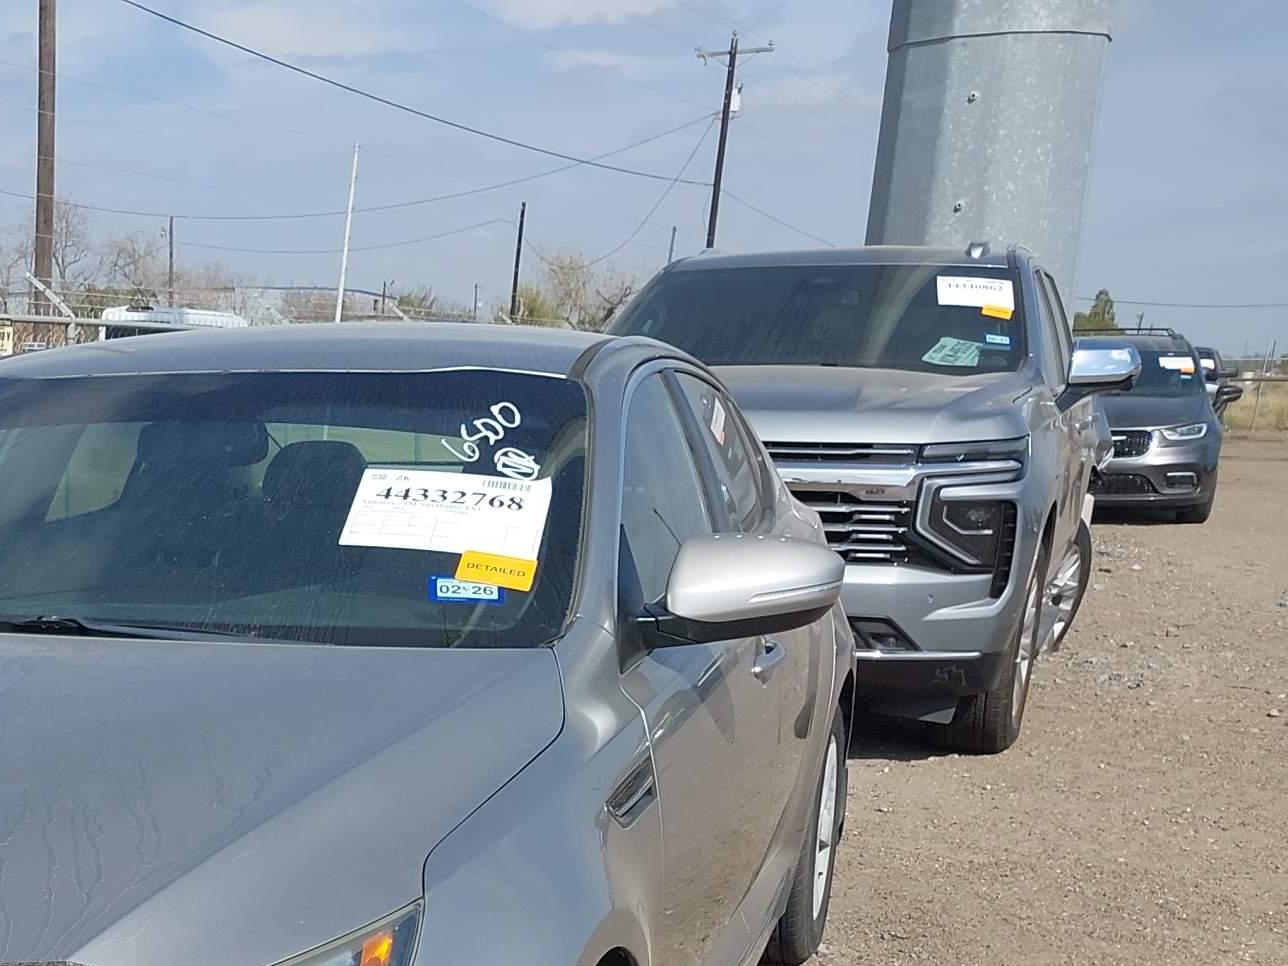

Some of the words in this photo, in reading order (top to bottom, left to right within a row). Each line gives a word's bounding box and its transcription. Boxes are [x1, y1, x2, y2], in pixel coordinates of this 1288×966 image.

[376, 486, 524, 511] 44332768
[466, 562, 526, 577] DETAILED
[439, 584, 462, 594] 02
[471, 585, 494, 596] 26
